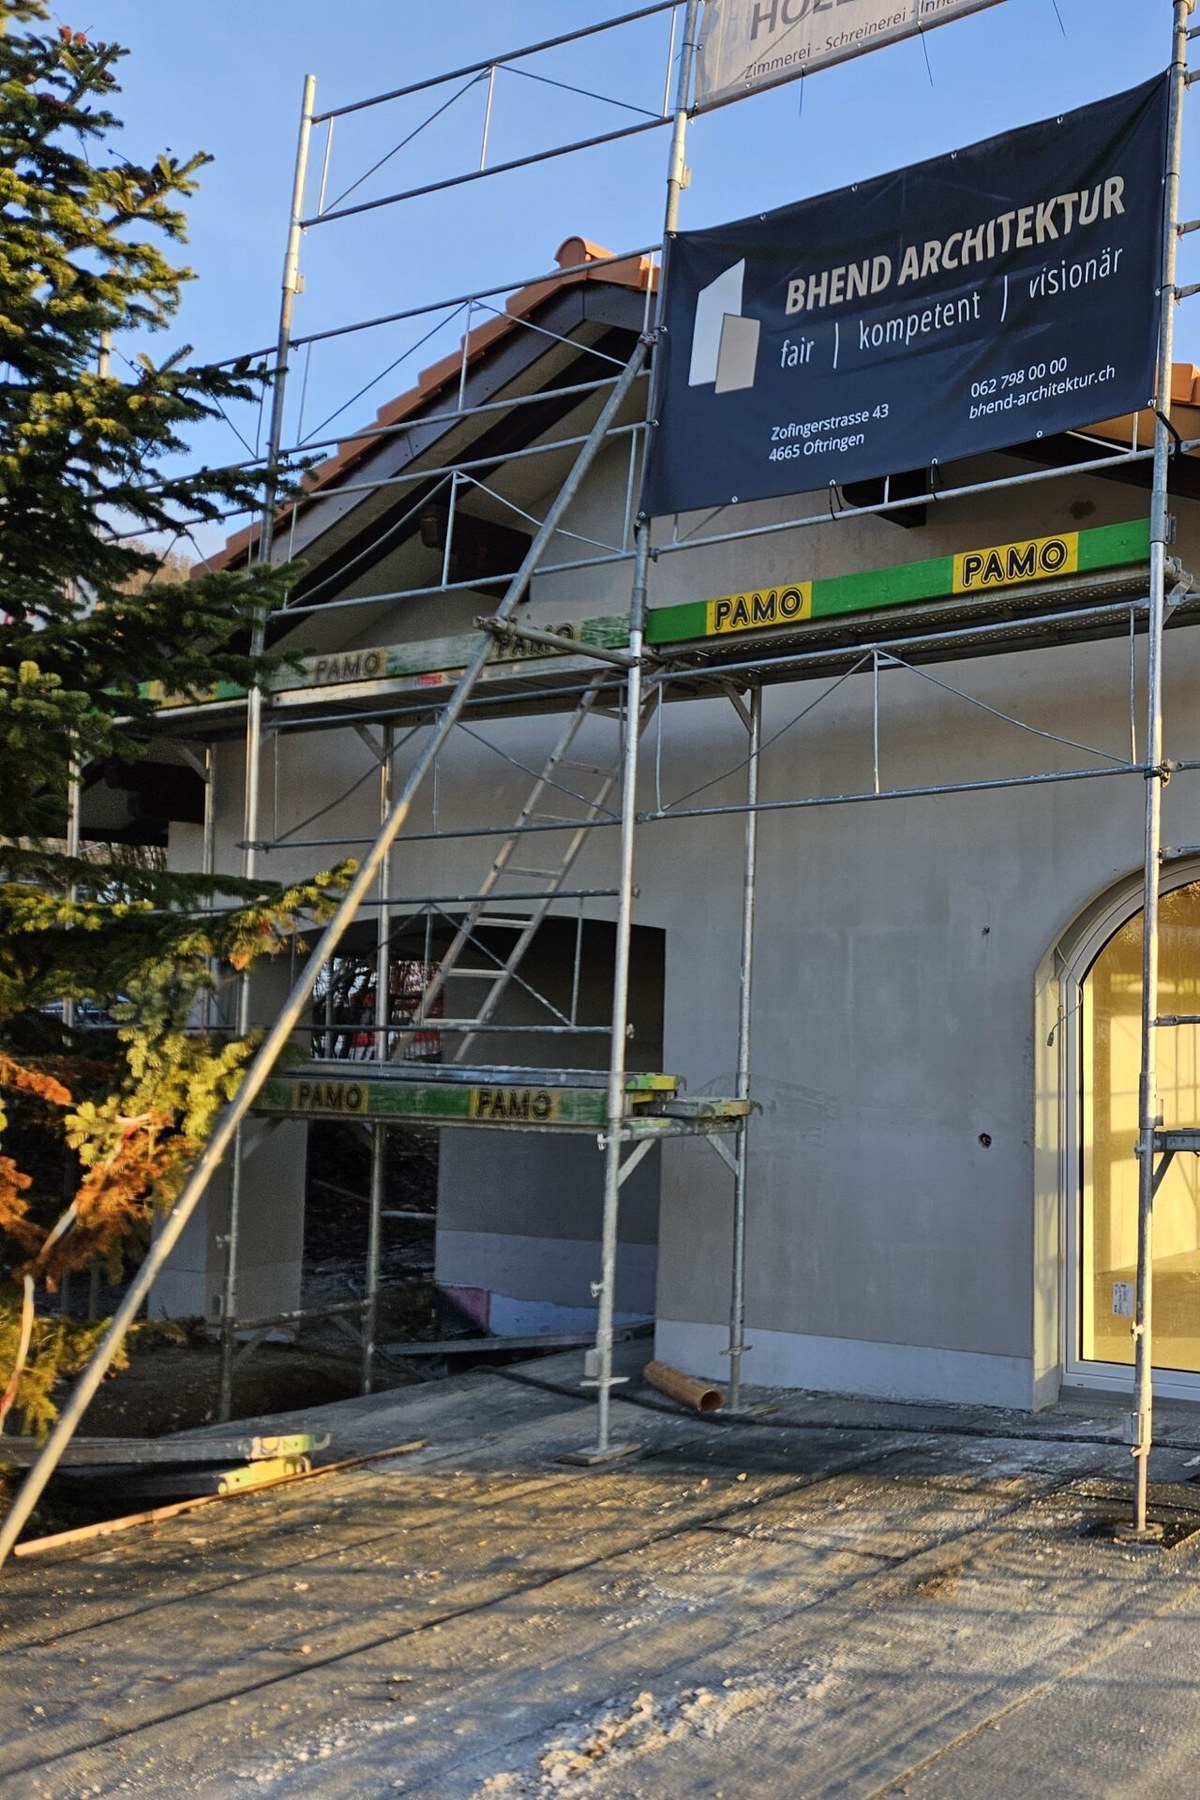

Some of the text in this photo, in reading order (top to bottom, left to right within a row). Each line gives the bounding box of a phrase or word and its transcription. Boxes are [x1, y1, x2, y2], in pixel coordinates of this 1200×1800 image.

[744, 43, 811, 79] Zimmerei
[825, 8, 906, 51] Schreinerei
[785, 175, 1126, 316] BHEND ARCHITEKTUR
[780, 337, 815, 368] fair
[859, 291, 981, 350] kompetent
[1028, 246, 1124, 298] visionär
[968, 364, 1116, 420] bhend-architektur.ch
[971, 357, 1068, 398] 062 798 00 00
[770, 403, 889, 442] Zofingerstrasse 43
[768, 432, 865, 462] 4665 Oftringen
[962, 538, 1069, 588] PAMO
[714, 586, 804, 631] PAMO
[315, 652, 379, 681] PAMO
[297, 1081, 363, 1111] PAMO
[475, 1088, 553, 1120] PAMO
